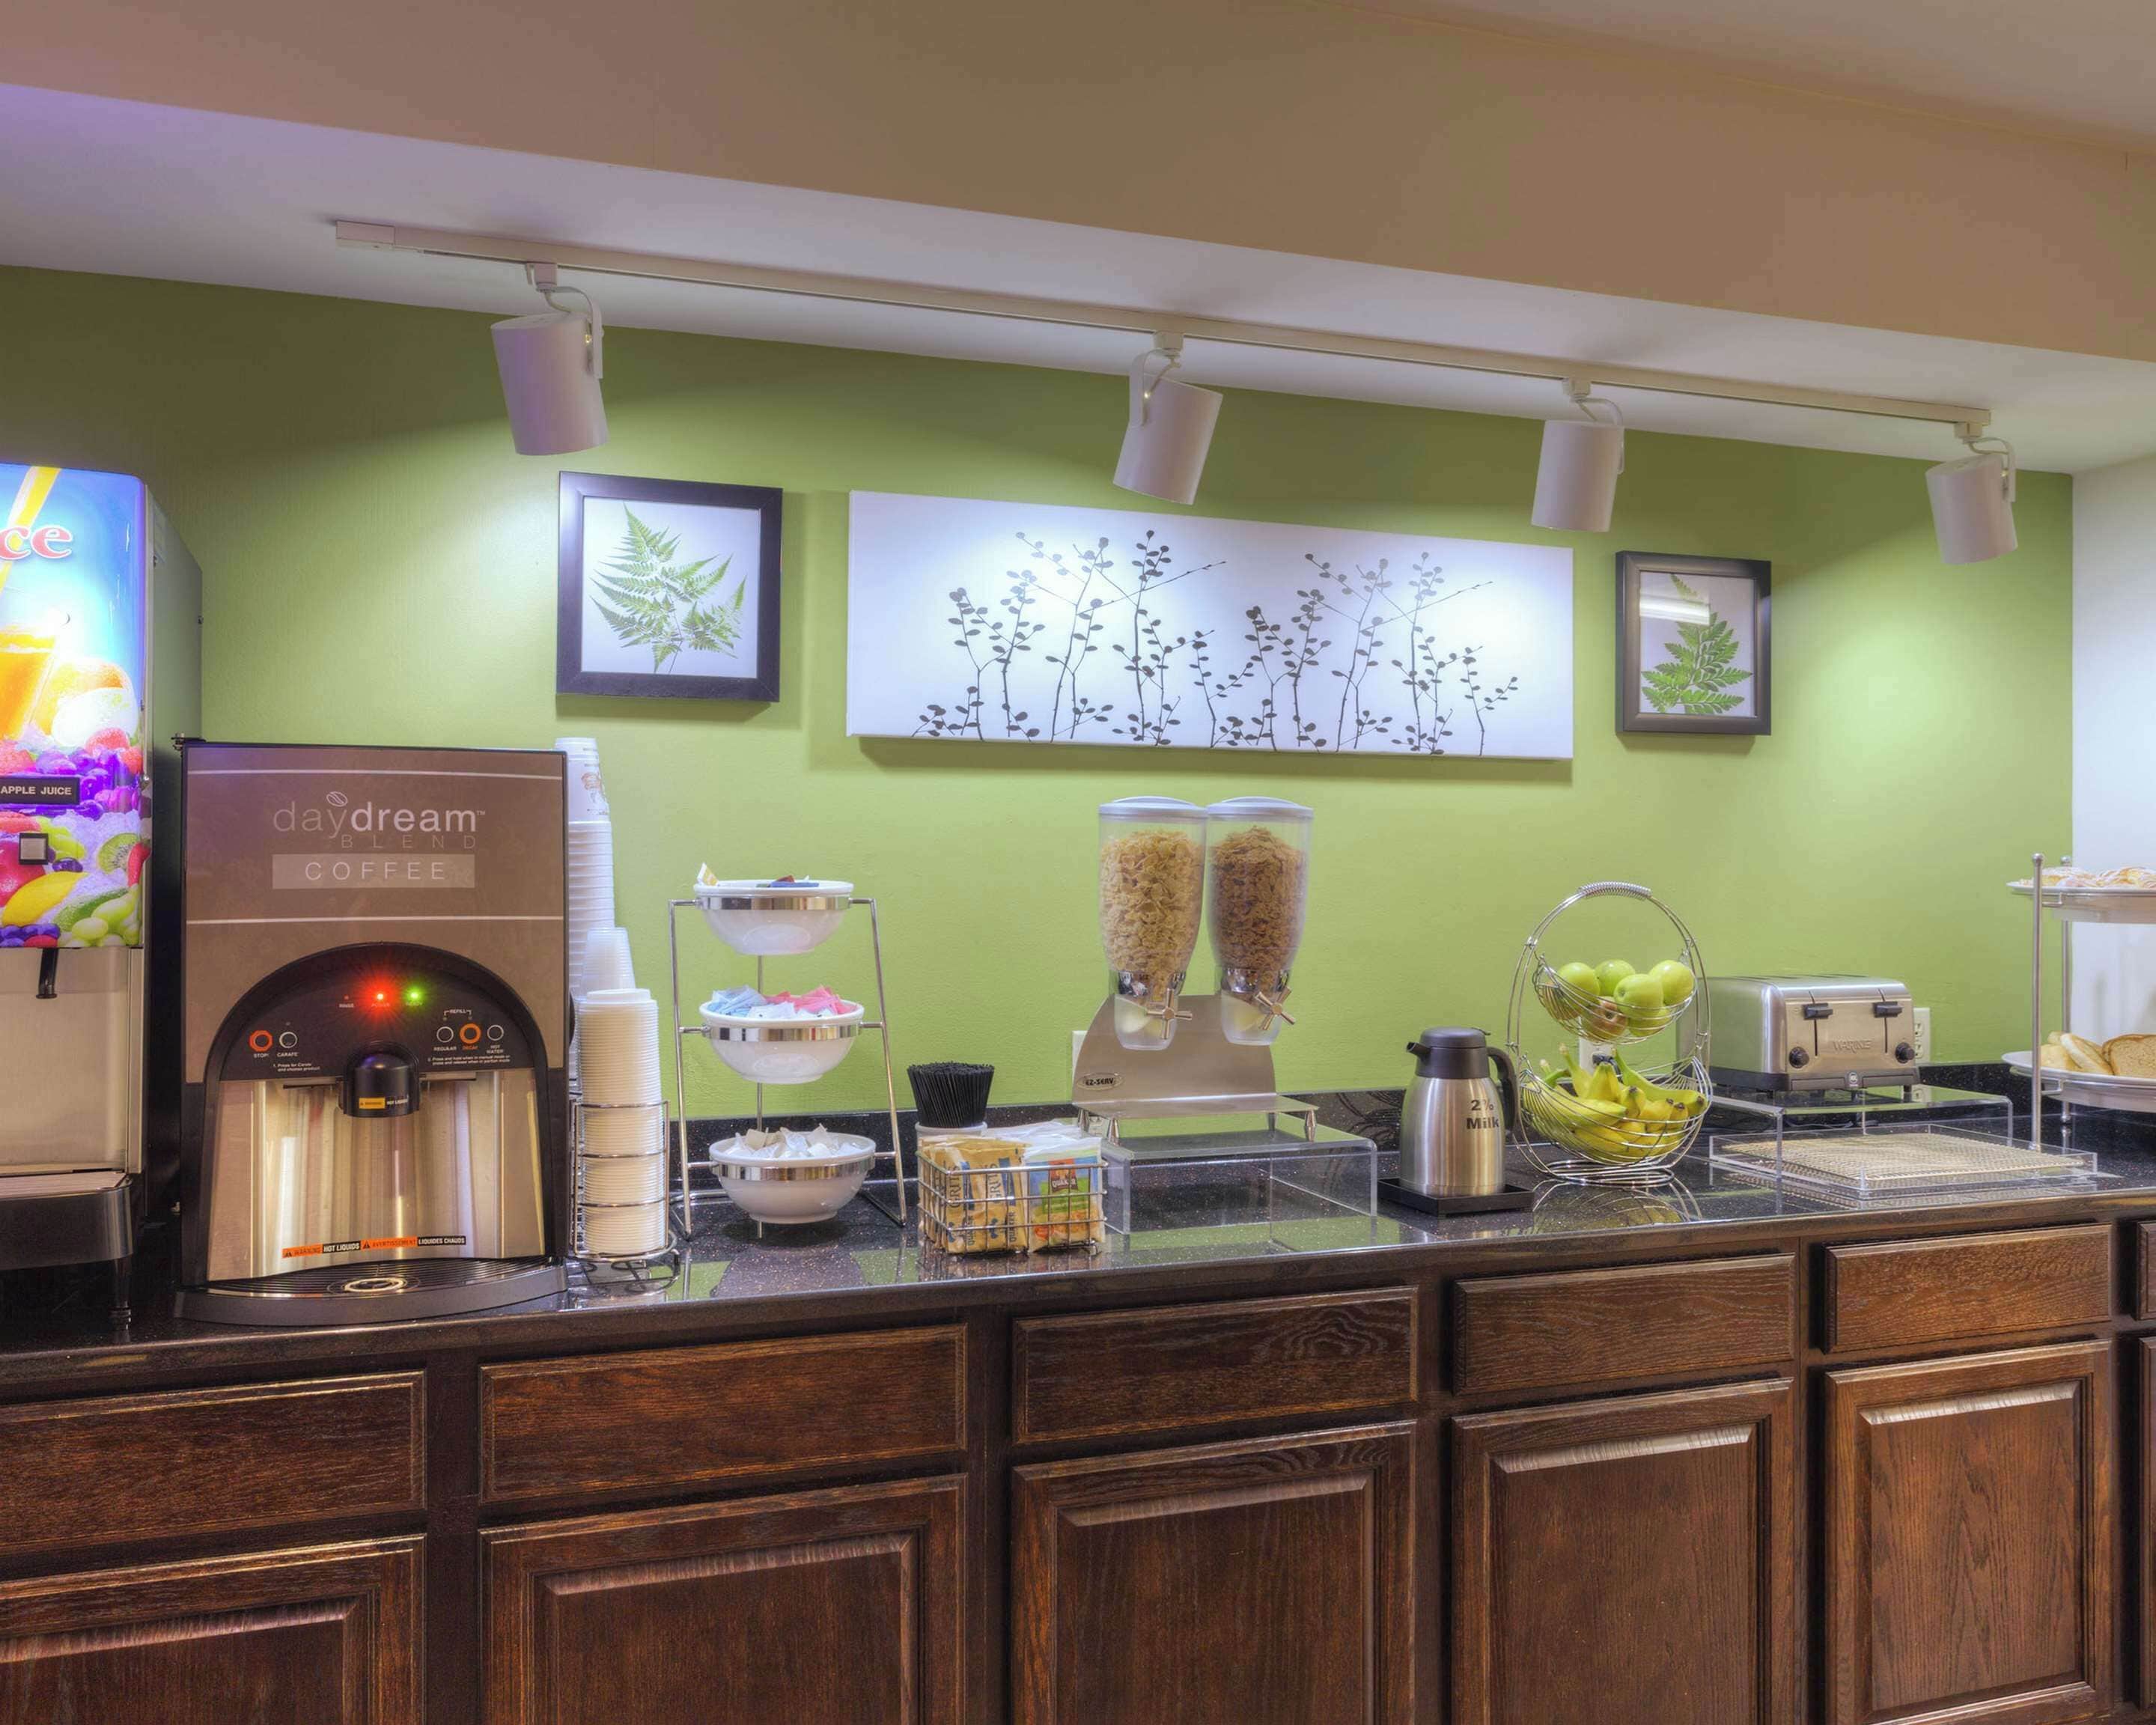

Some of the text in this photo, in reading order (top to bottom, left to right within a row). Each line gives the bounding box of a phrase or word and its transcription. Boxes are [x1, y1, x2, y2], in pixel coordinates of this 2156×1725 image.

[40, 787, 72, 795] JUICE
[341, 834, 476, 848] BLEND
[305, 862, 445, 880] COFFEE
[1471, 1099, 1494, 1110] 2%
[1467, 1116, 1499, 1129] Milk
[323, 1244, 335, 1253] HOT
[336, 1243, 360, 1251] LIQUIDS
